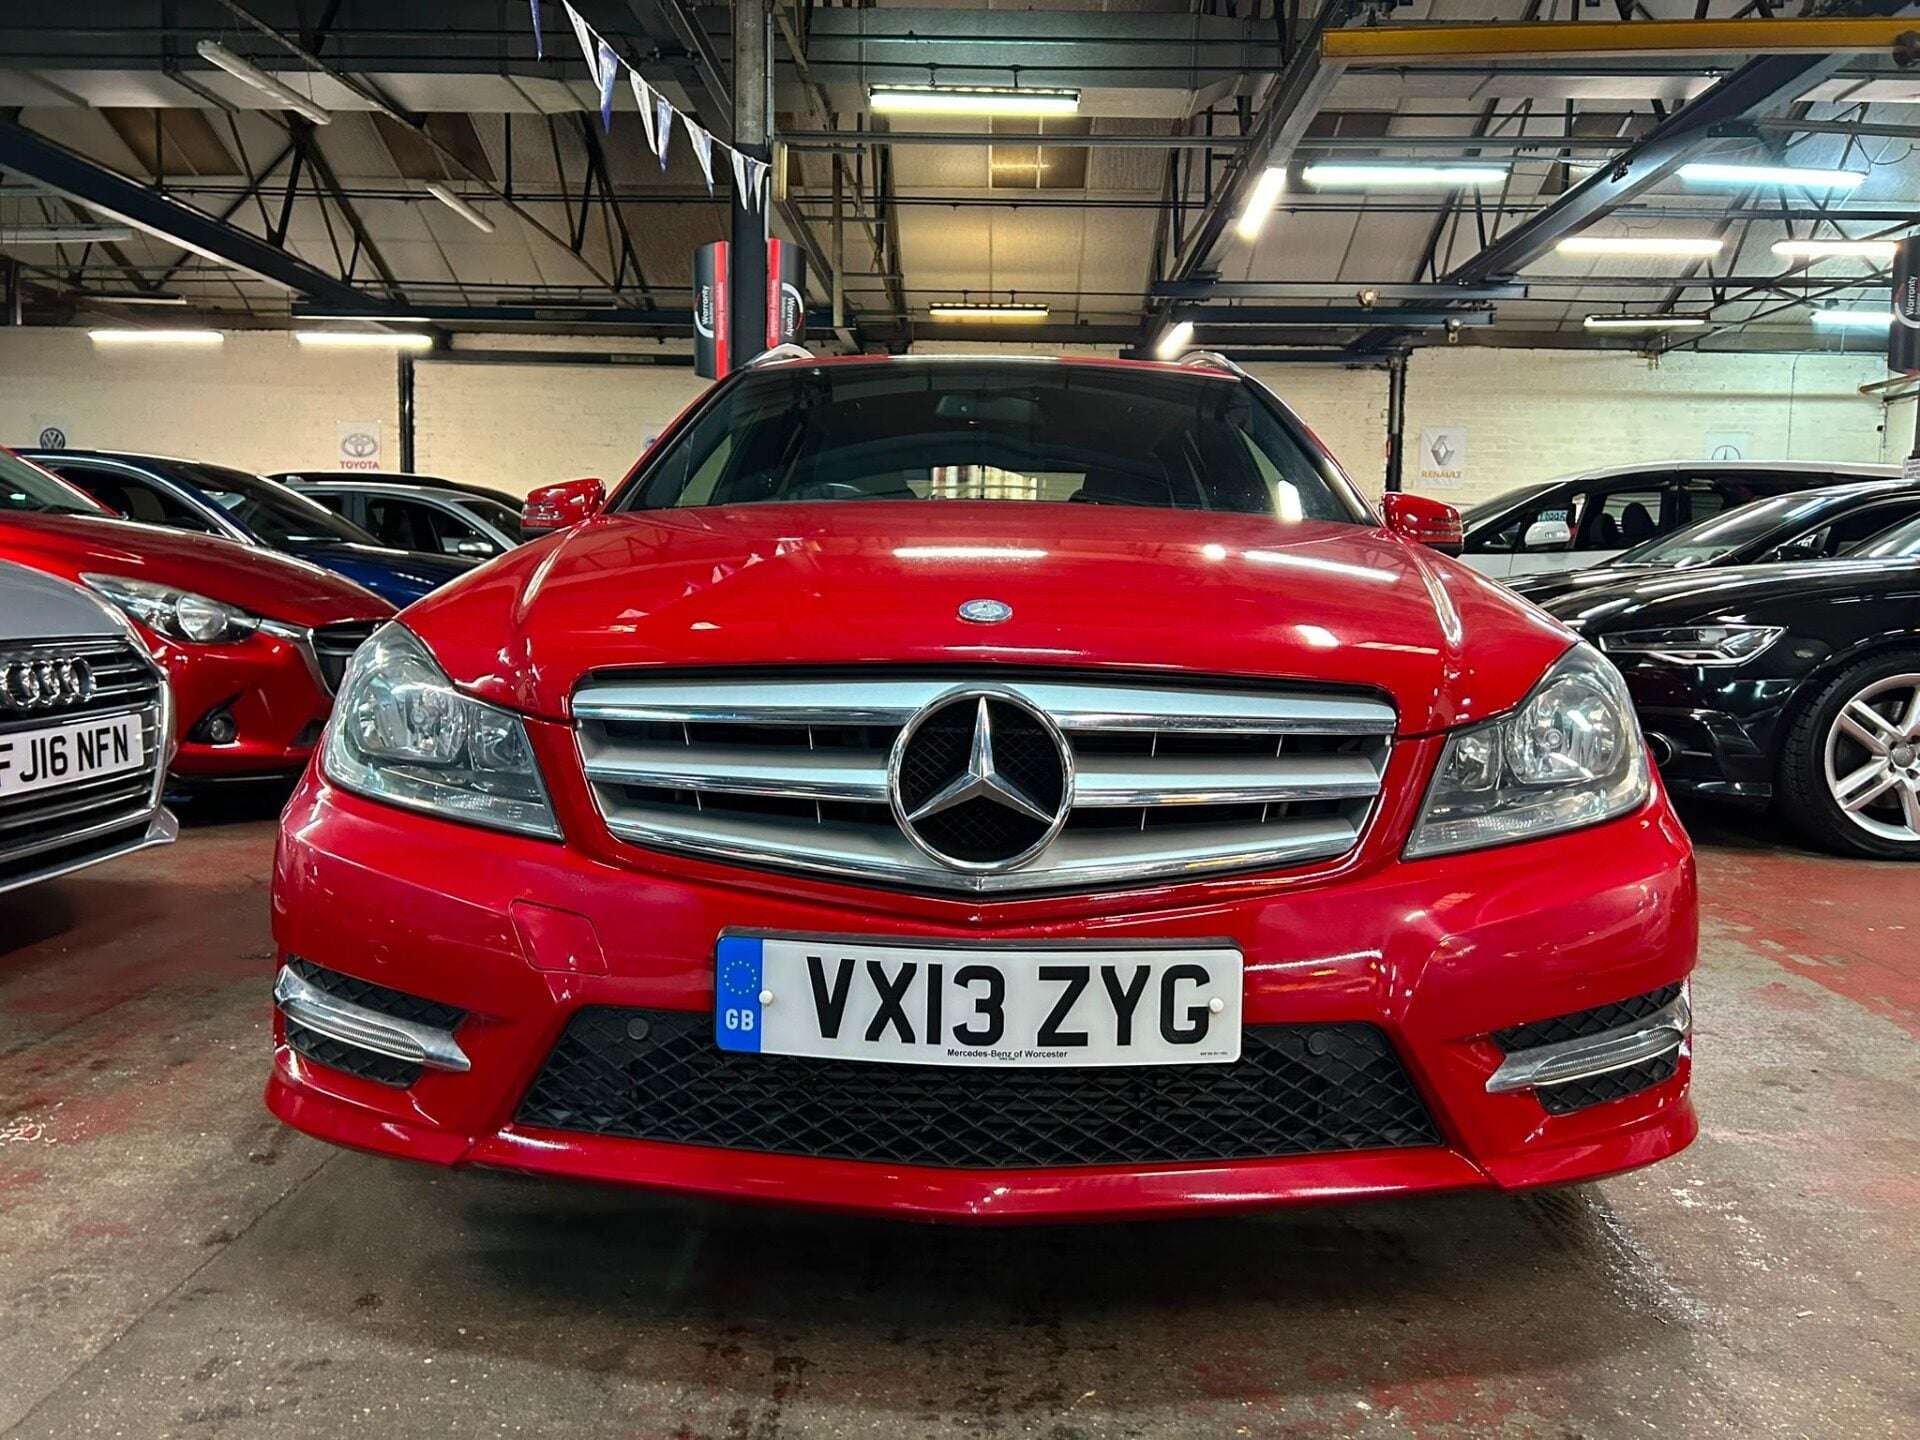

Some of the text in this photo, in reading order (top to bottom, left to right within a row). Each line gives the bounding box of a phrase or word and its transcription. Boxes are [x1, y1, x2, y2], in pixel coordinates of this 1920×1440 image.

[702, 285, 710, 325] Warranty
[1905, 276, 1918, 316] Warranty
[784, 297, 796, 336] Warranty
[340, 461, 380, 469] TOYOTA
[76, 724, 129, 771] NFN
[726, 1009, 753, 1031] GB
[807, 956, 1211, 1047] VX13 ZYG
[947, 1049, 1011, 1058] Mercedes-Benz
